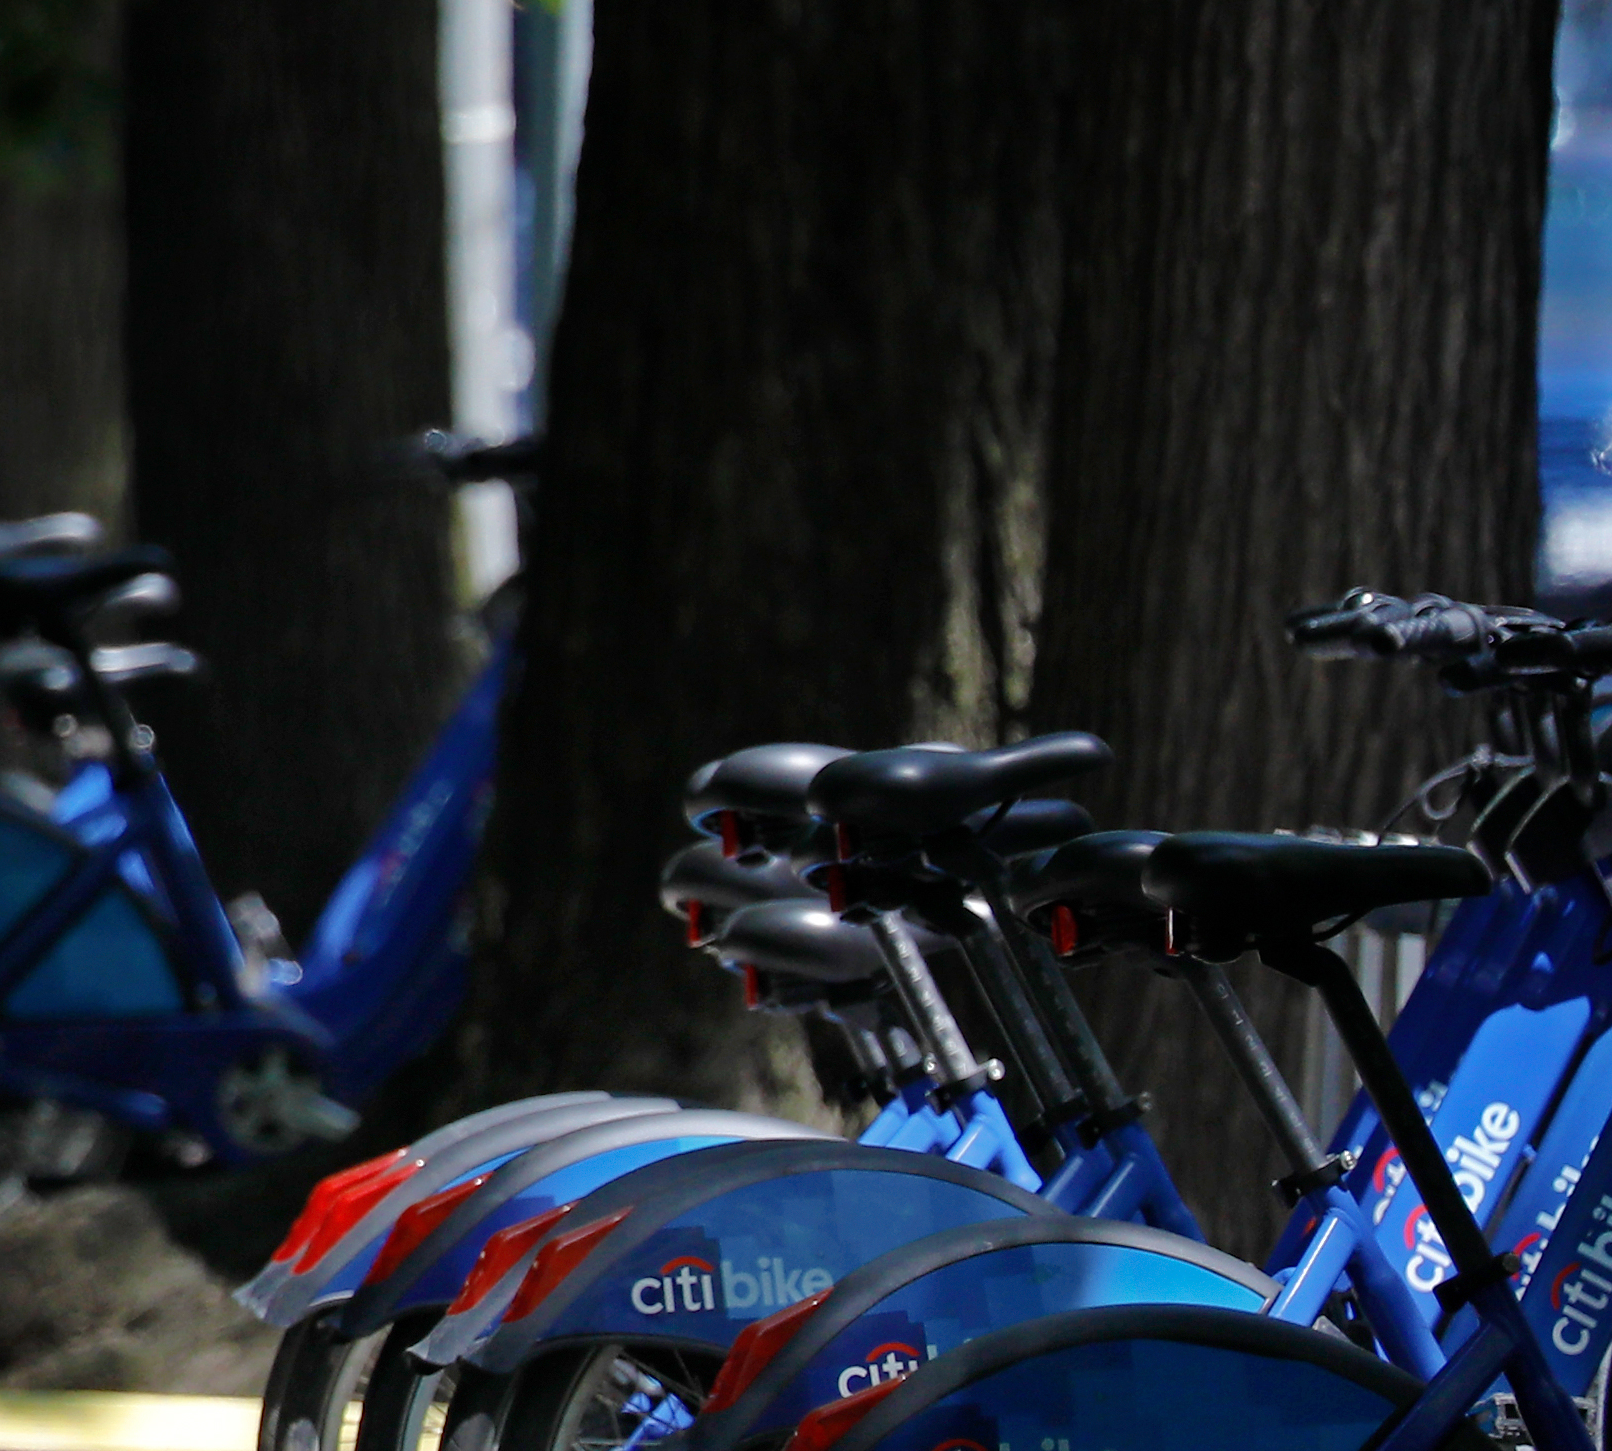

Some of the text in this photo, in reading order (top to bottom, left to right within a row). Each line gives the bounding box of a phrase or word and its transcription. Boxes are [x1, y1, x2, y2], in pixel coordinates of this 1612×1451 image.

[631, 1256, 715, 1315] citi
[1404, 1205, 1452, 1293] cit
[1551, 1261, 1612, 1356] citi
